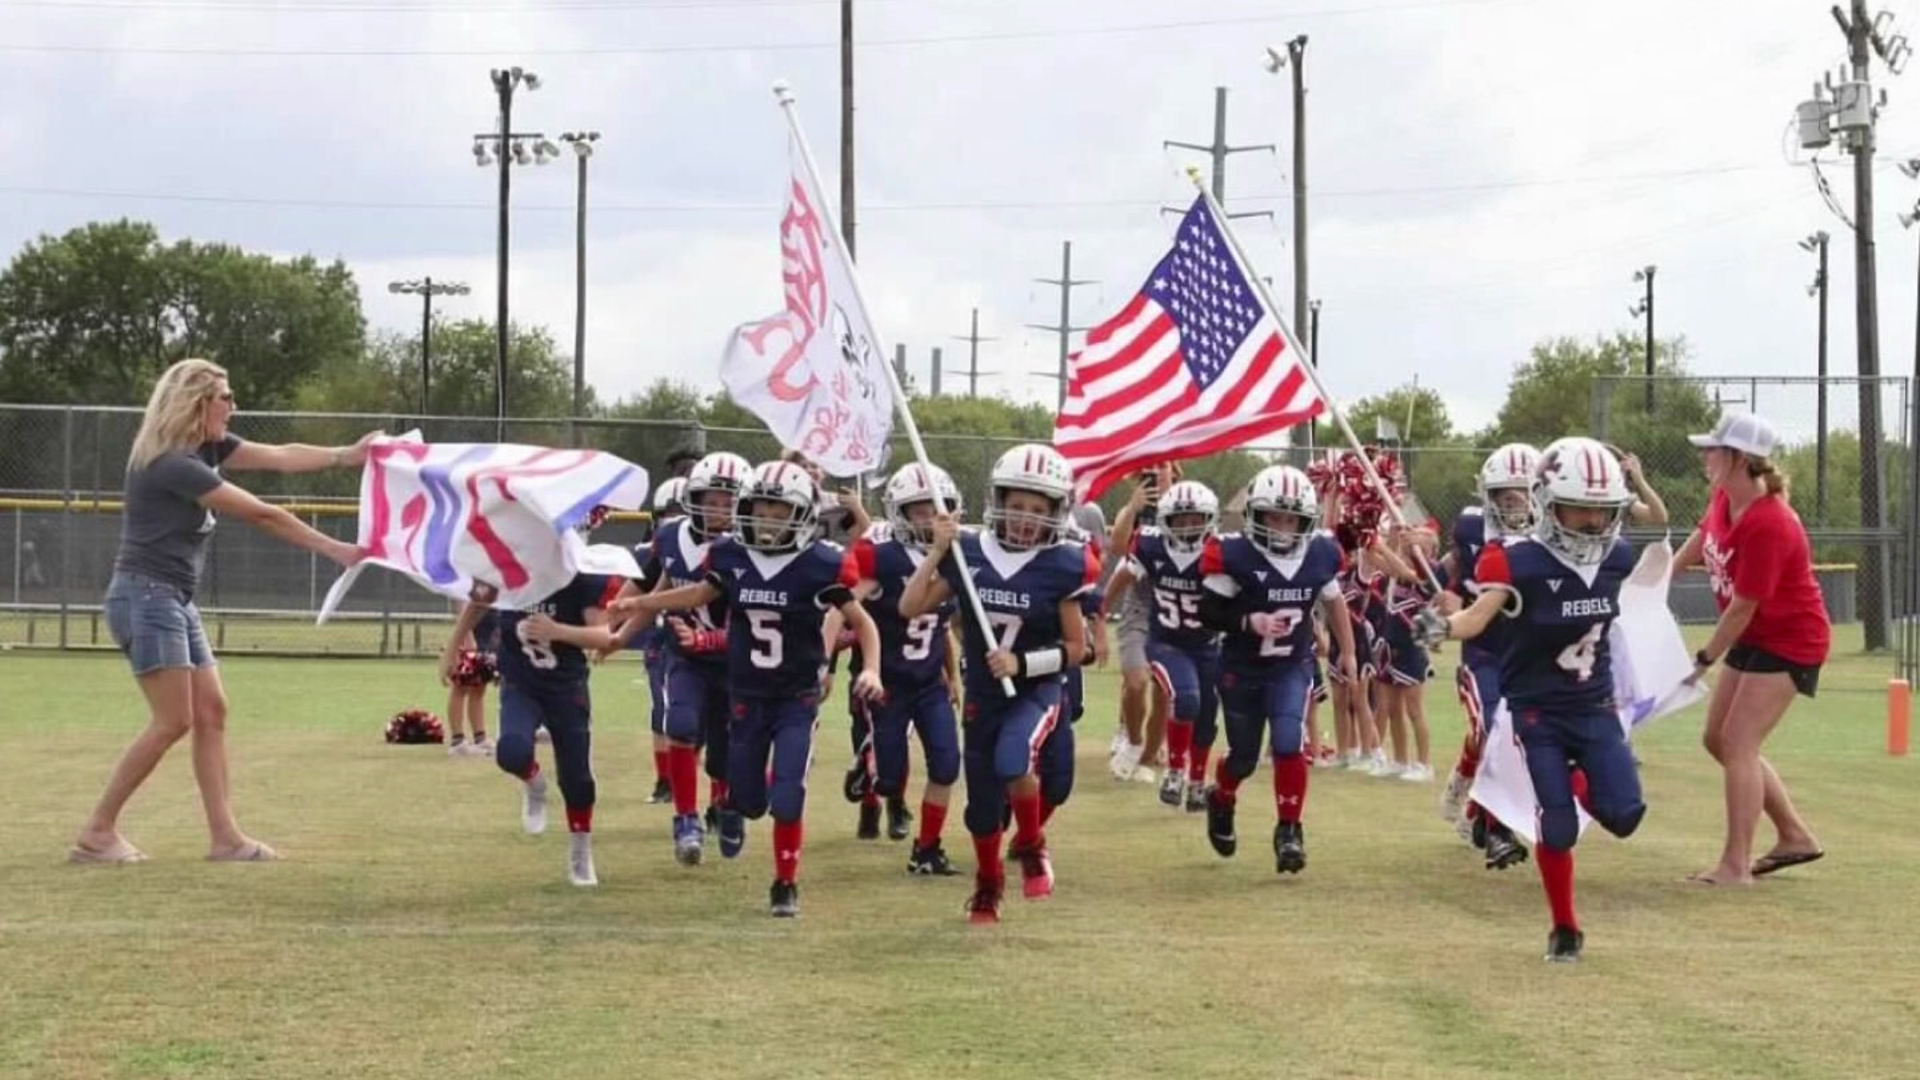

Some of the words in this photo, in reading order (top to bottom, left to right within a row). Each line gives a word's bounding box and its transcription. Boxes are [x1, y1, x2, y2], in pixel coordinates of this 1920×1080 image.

[740, 588, 787, 606] REBELS
[979, 588, 1030, 609] REBELS
[1154, 588, 1203, 628] 55
[1268, 588, 1312, 601] REBELS
[1562, 598, 1611, 617] REBELS
[745, 609, 782, 668] 5
[903, 613, 939, 660] 9
[985, 611, 1022, 650] 7
[1260, 608, 1303, 656] 2
[1556, 622, 1604, 681] 4
